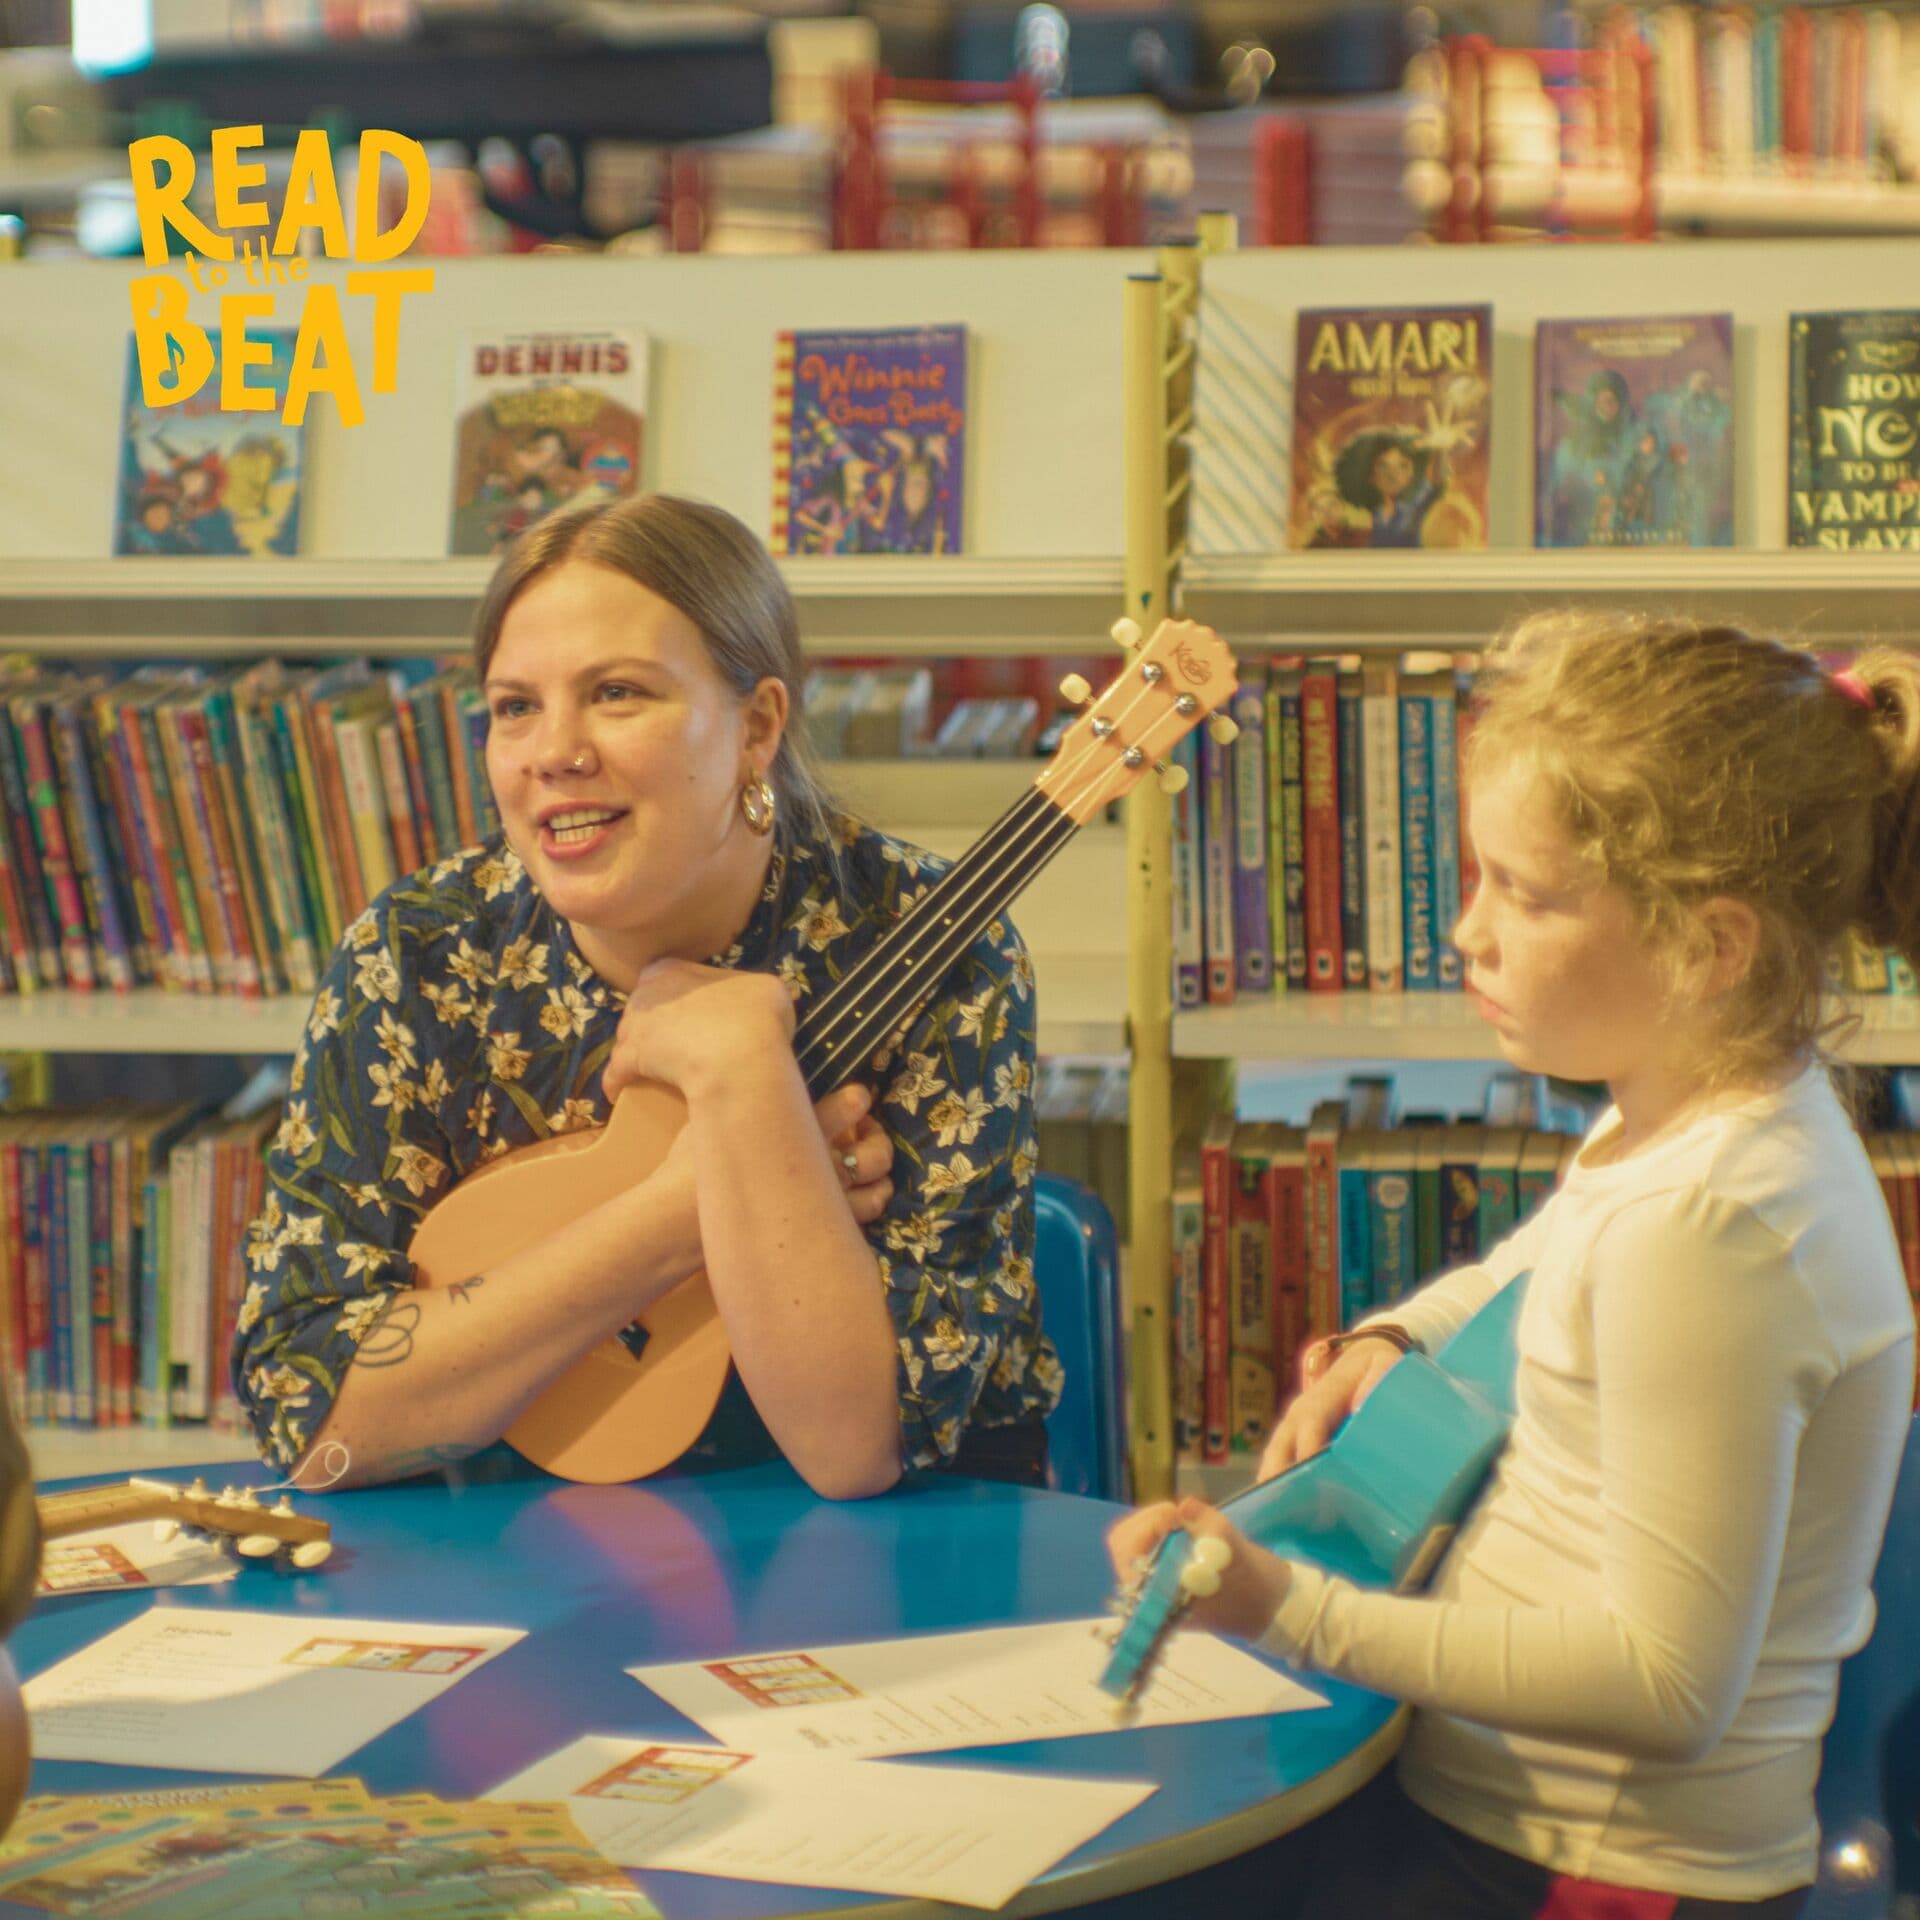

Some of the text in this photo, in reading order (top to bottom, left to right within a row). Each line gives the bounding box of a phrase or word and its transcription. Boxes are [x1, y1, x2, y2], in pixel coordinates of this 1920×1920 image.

[474, 341, 630, 376] DENNIS
[1307, 316, 1478, 375] AMARI
[799, 352, 946, 403] Winnie
[1818, 405, 1920, 458] NO
[1840, 461, 1876, 481] TO
[1794, 489, 1920, 526] VAMP
